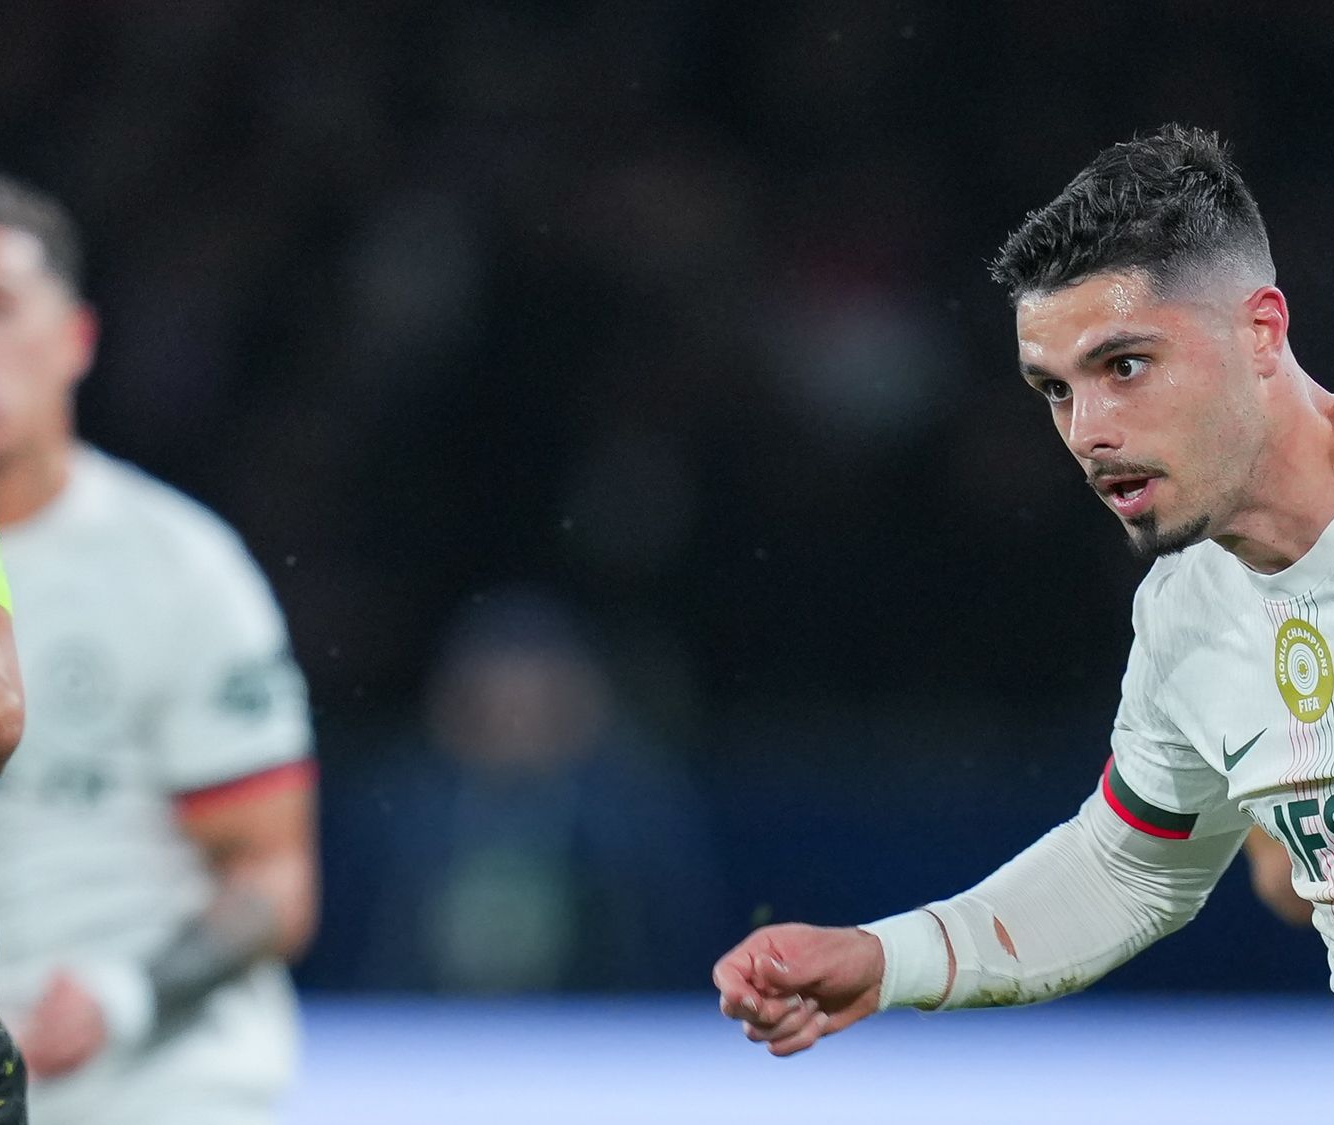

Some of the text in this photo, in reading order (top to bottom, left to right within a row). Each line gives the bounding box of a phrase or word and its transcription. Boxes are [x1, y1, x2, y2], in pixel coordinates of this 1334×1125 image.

[1278, 627, 1329, 686] WORLD CHAMPIONS
[1298, 696, 1321, 713] FIFA
